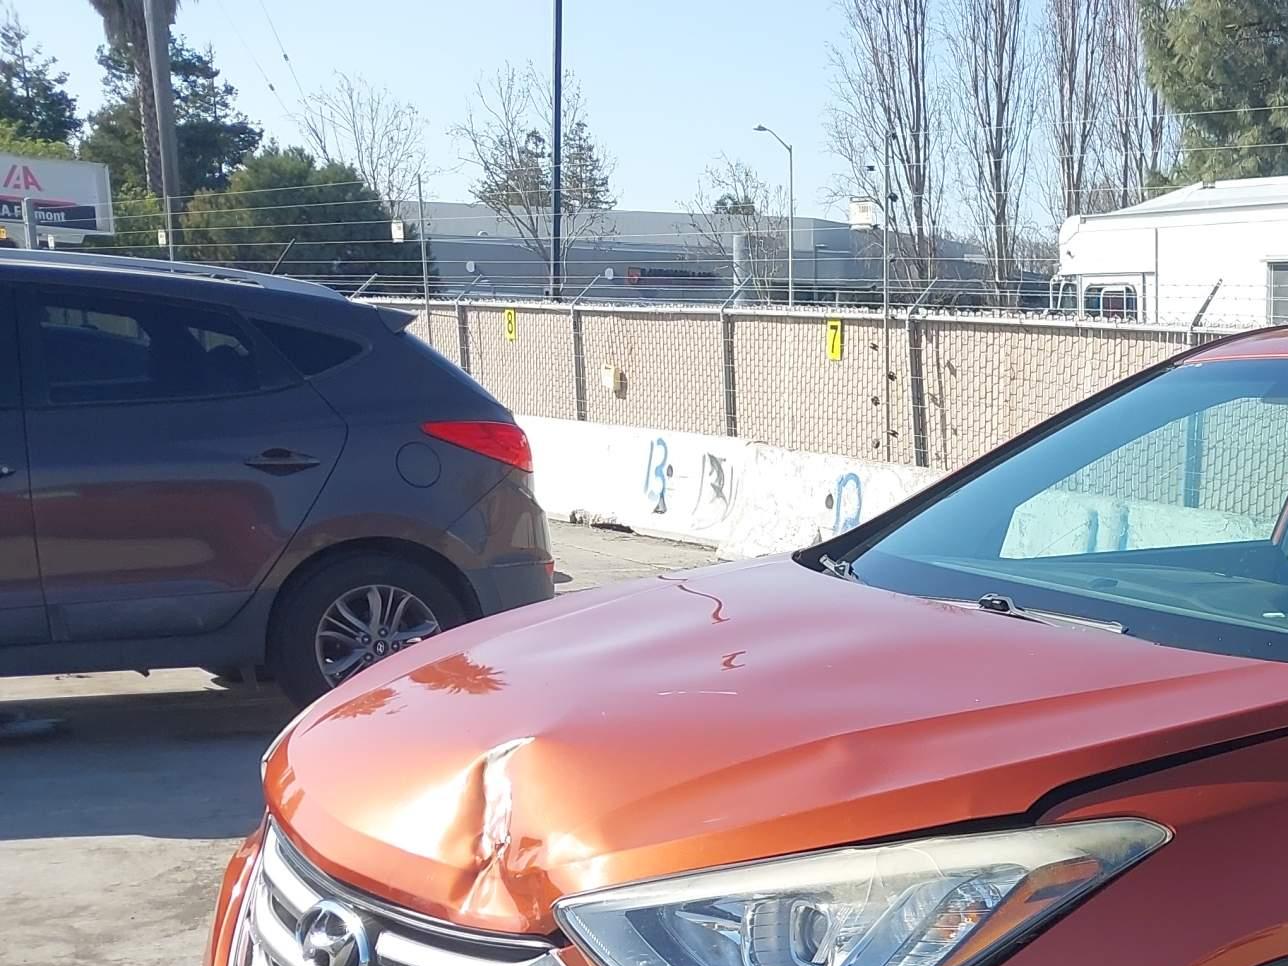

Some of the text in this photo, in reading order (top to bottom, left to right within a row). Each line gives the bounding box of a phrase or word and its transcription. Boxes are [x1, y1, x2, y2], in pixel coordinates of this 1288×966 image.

[14, 205, 66, 222] Fmont
[507, 311, 513, 334] 8
[830, 324, 838, 353] 7
